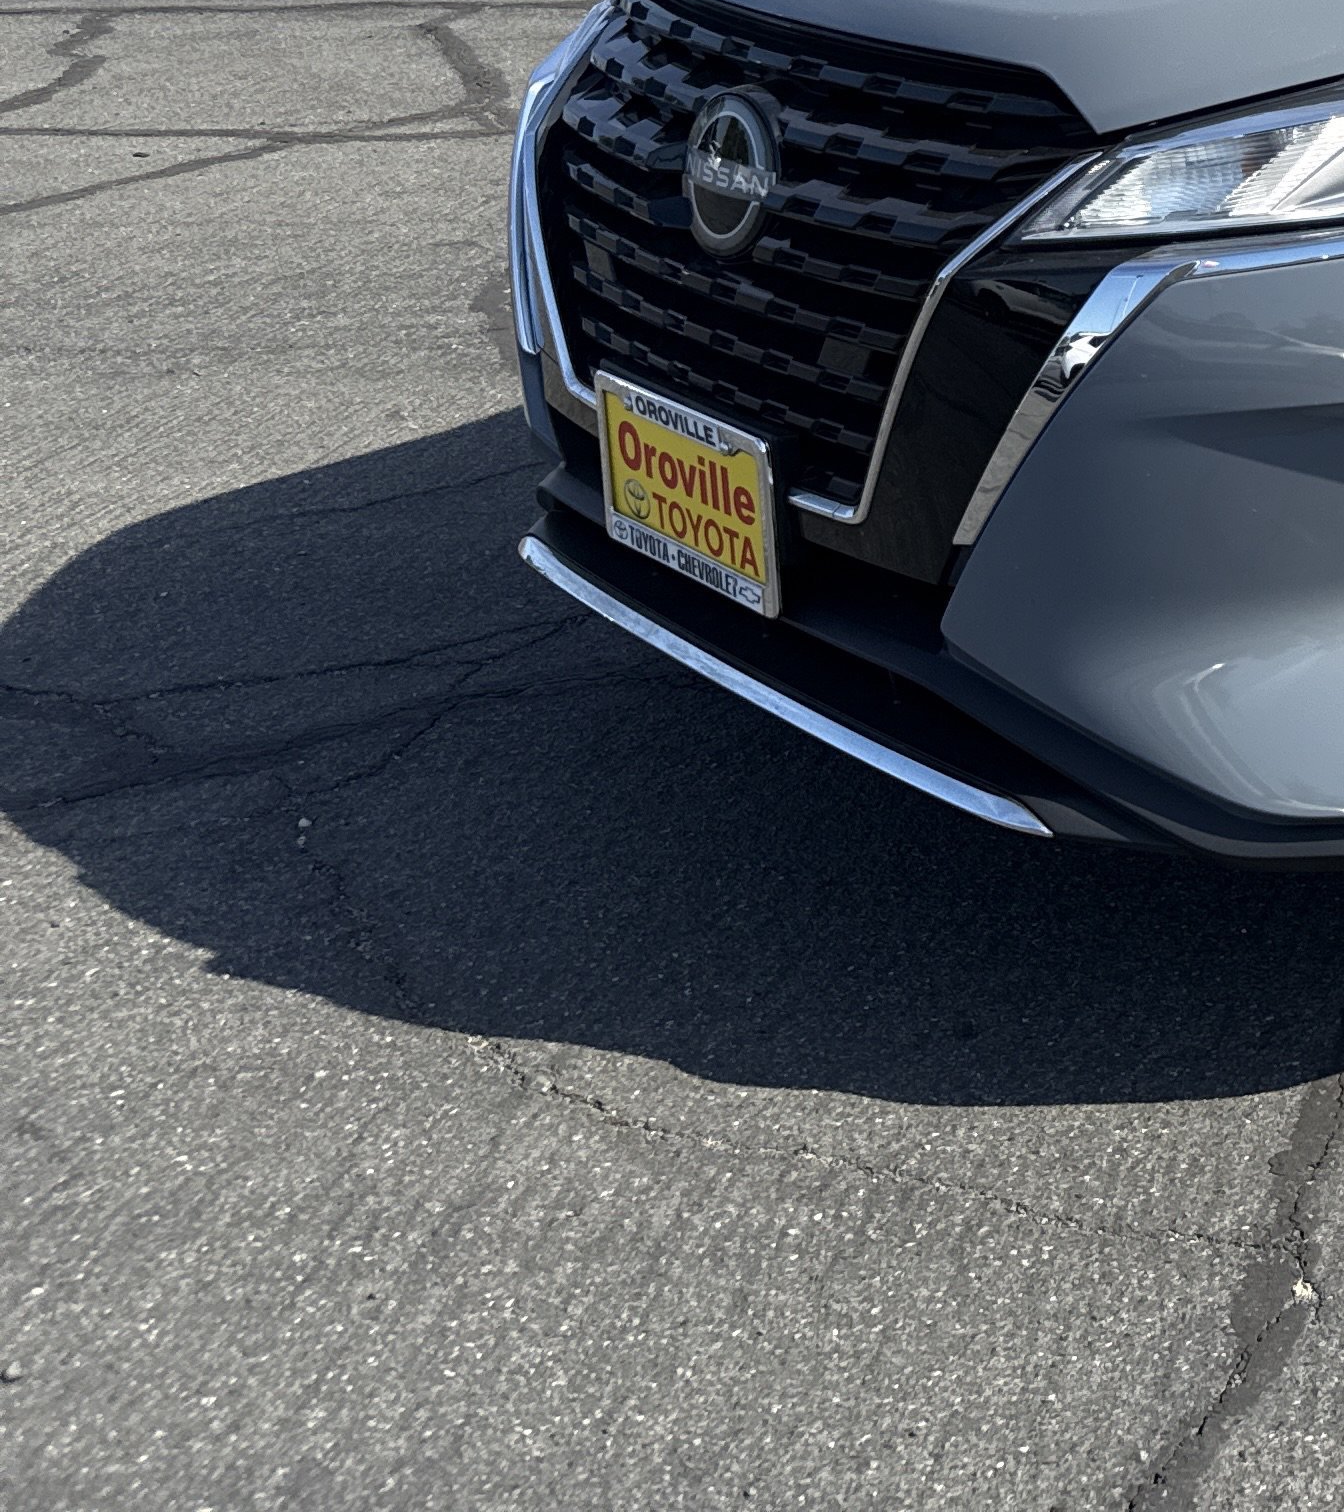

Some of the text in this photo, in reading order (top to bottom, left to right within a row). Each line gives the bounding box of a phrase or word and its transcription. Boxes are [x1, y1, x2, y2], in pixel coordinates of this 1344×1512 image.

[686, 152, 769, 198] NISSAN
[634, 395, 717, 447] OROVILLE
[617, 420, 757, 526] Oroville
[628, 524, 740, 599] TOYOTA CHEVROLET
[652, 491, 760, 578] TOYOTA
